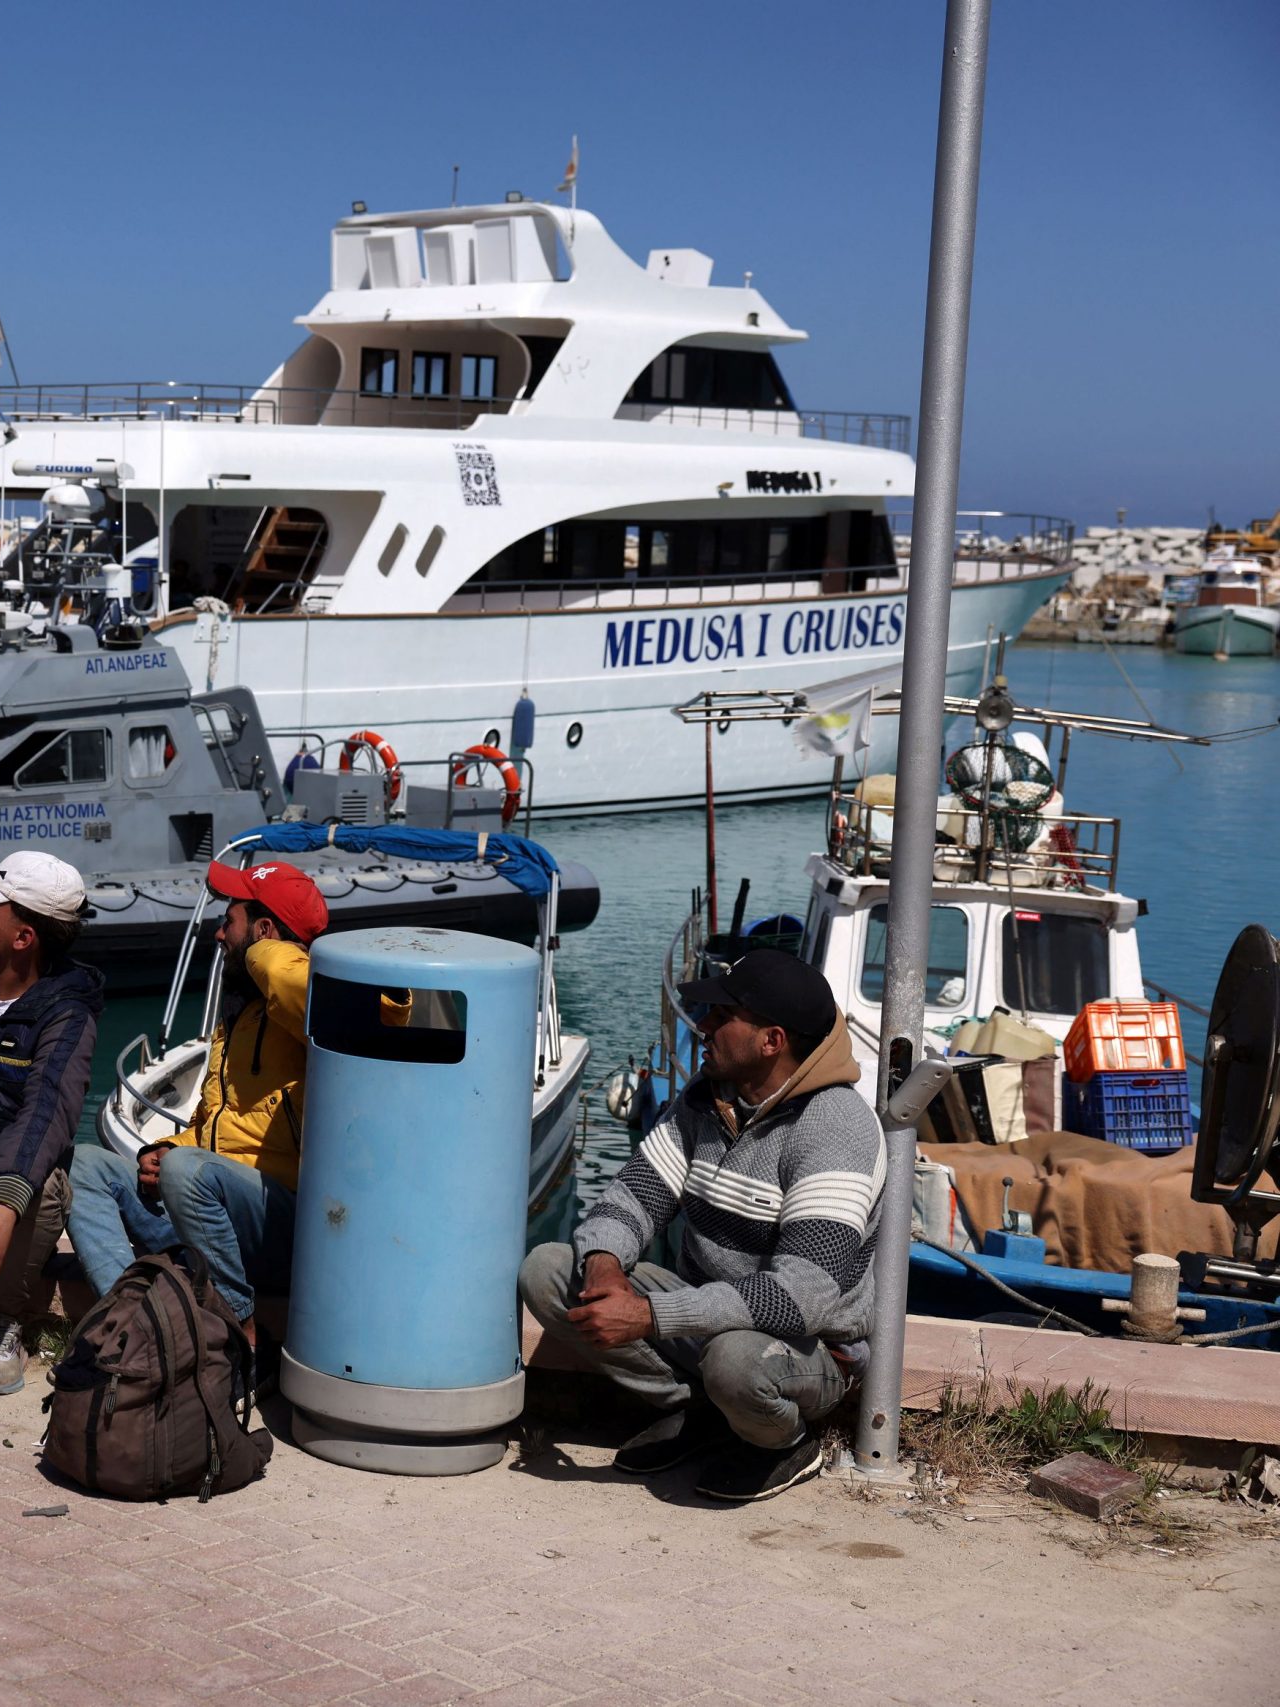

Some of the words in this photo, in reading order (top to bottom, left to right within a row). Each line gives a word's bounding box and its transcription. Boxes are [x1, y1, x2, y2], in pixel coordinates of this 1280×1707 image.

[603, 614, 745, 669] MEDUSA
[755, 613, 772, 658] I
[783, 602, 905, 656] CRUISES
[86, 652, 168, 675] ΑΠ.ΑΝΔΡΕΑΣ
[13, 803, 106, 822] ΑΣΤΥΝΟΜΙΑ
[27, 822, 82, 840] POLICE
